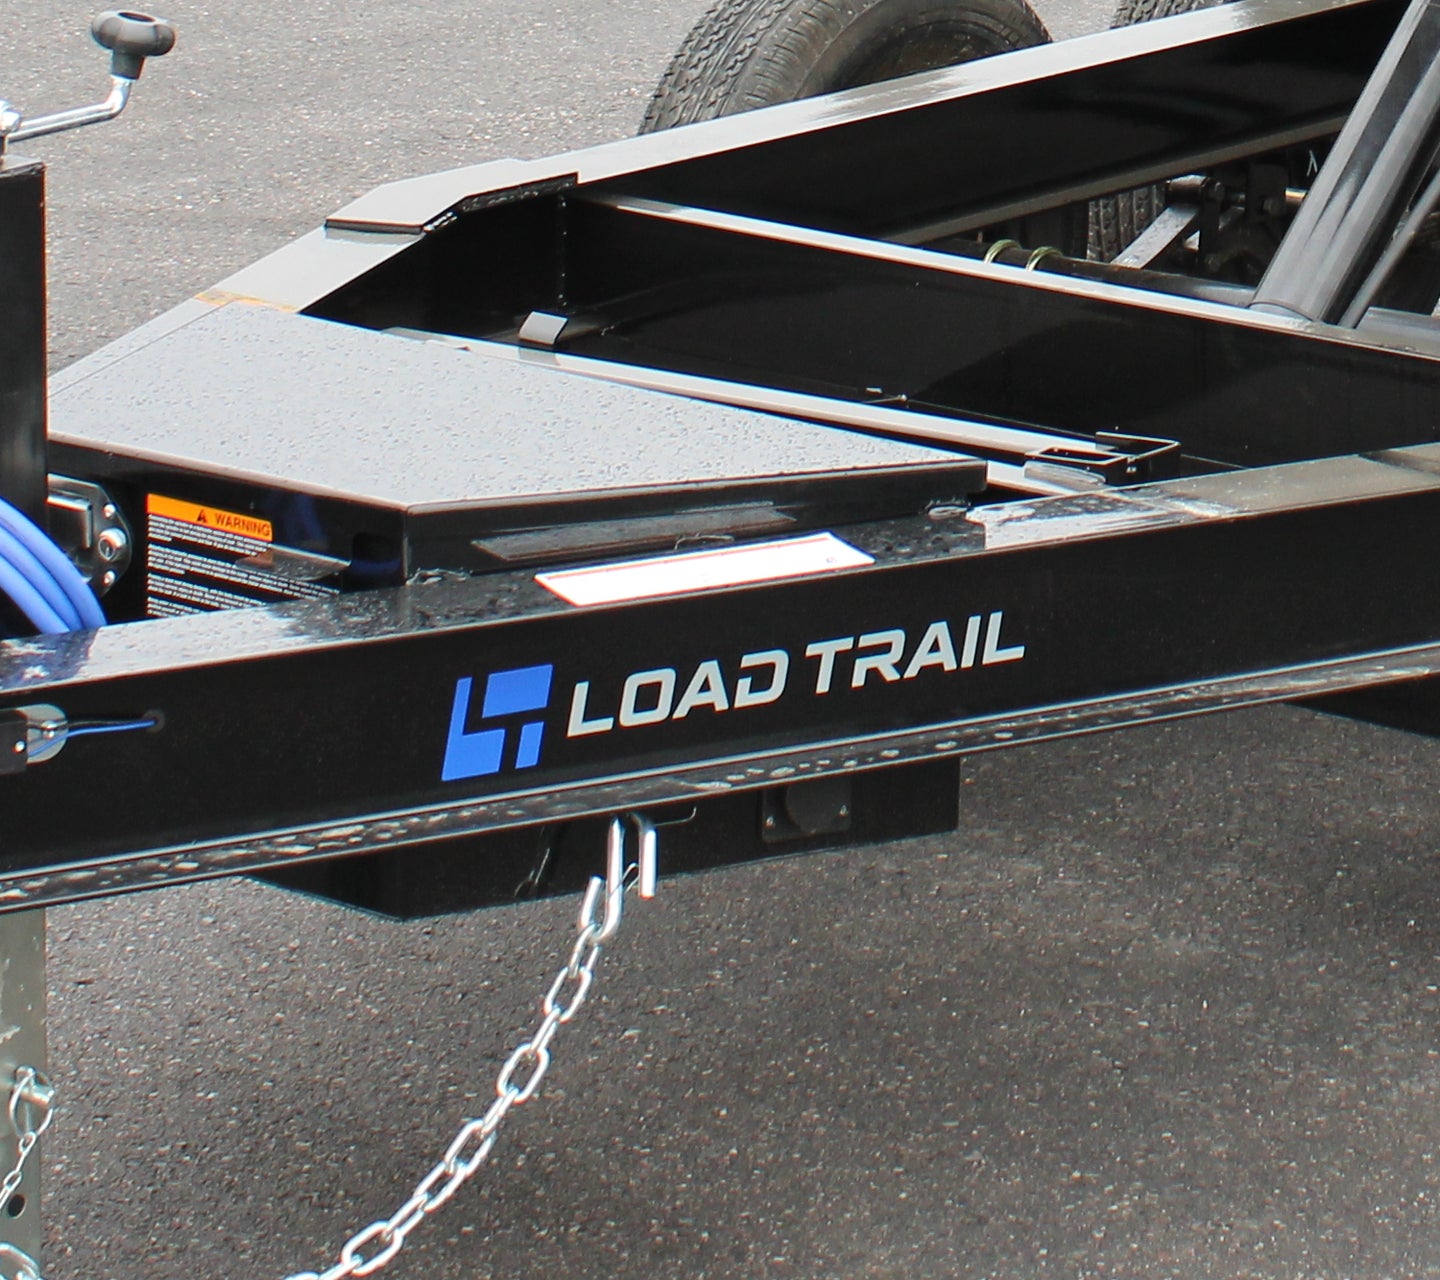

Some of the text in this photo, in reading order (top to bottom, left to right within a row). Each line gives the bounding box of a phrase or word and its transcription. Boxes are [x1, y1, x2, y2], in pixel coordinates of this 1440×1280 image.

[214, 512, 271, 537] WARNING
[566, 610, 1026, 739] LOAD TRAIL
